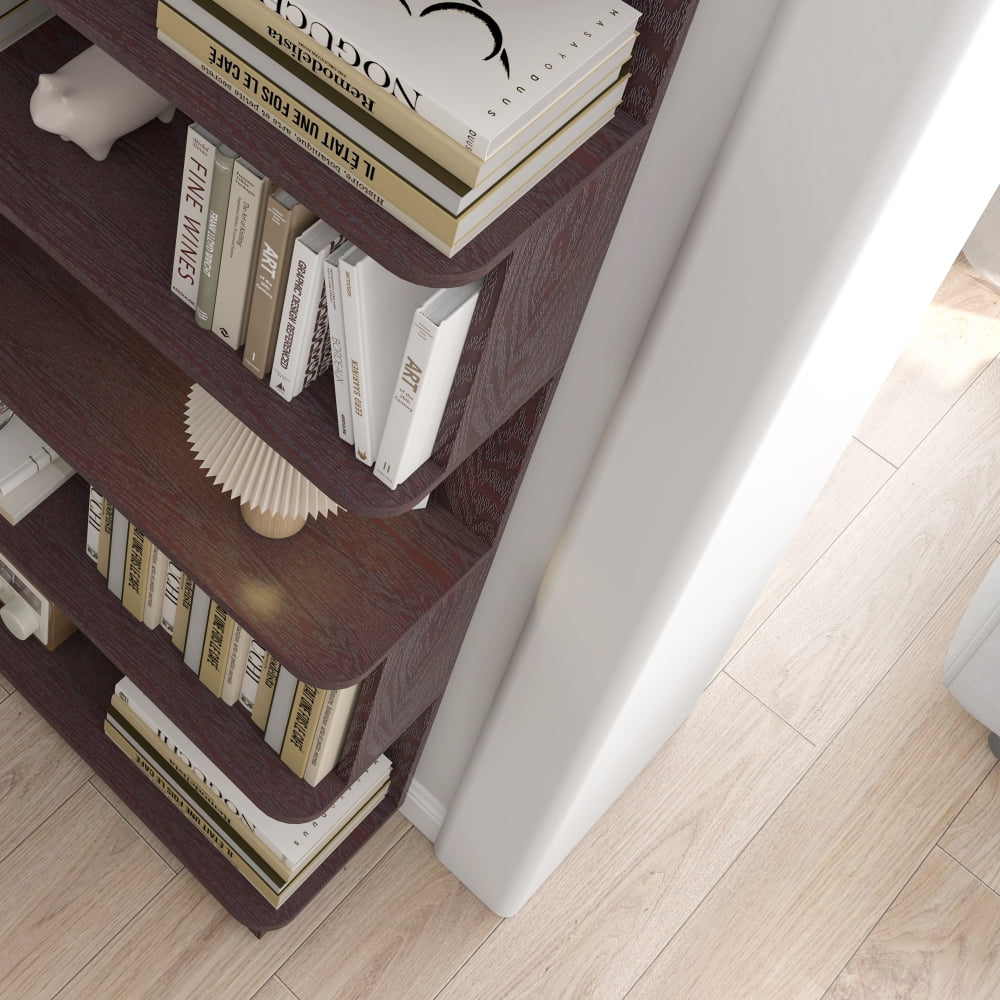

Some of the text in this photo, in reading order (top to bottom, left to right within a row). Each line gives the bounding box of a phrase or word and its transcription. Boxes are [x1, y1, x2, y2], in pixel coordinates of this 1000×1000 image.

[266, 24, 376, 114] Remodelista
[487, 8, 619, 118] MASAYO DUUS
[208, 45, 376, 182] IL ÉTAIT UNE FOIS LE CAFÉ
[178, 156, 208, 286] FINE WINES
[261, 242, 279, 279] ART
[281, 260, 308, 370] GRAPHIC DESIGN REFERENCED
[332, 336, 345, 385] BORDEAUX
[351, 359, 363, 417] EERO SAARINEN
[402, 355, 422, 394] ART
[158, 728, 256, 832] NOGUCHI
